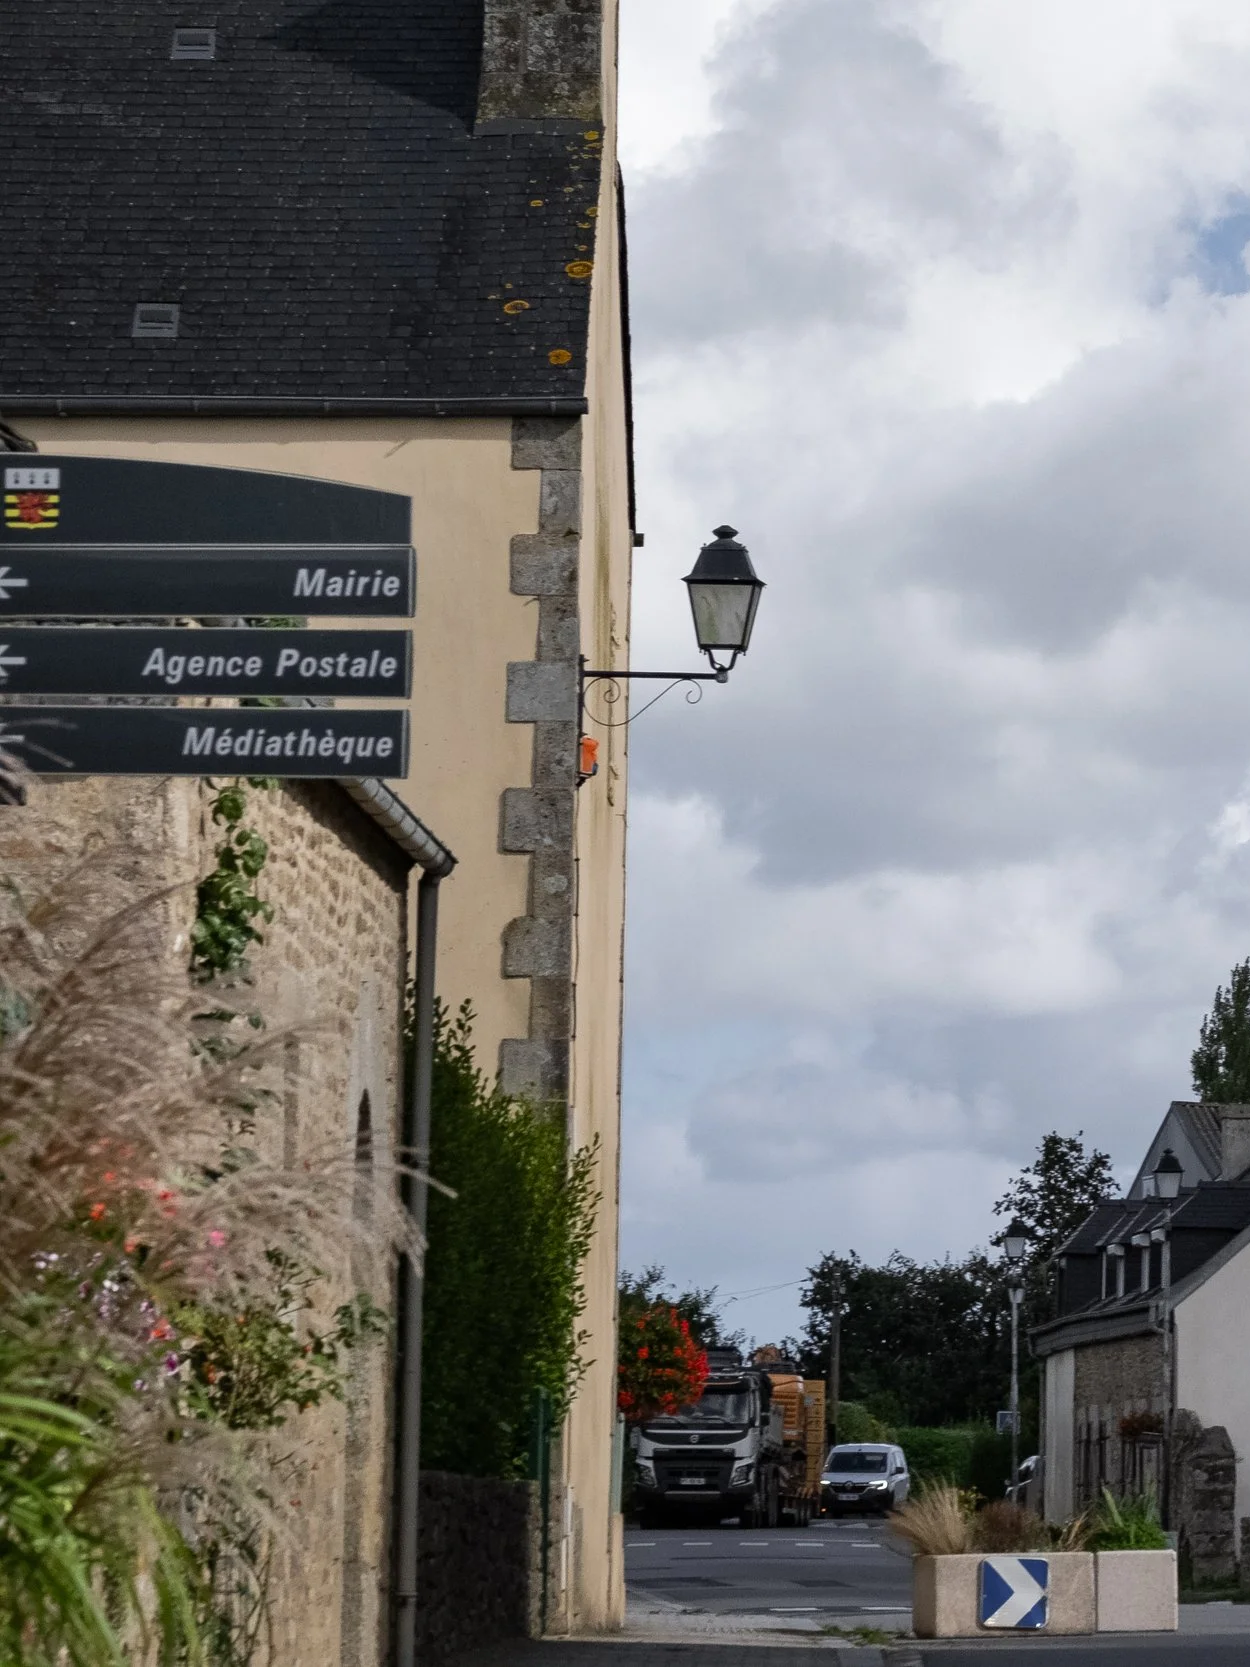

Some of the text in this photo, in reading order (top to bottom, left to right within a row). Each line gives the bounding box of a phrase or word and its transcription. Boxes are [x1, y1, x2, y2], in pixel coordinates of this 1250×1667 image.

[293, 568, 401, 597] Mairie
[142, 647, 398, 683] Agence Postale
[182, 727, 393, 764] Médiathèque
